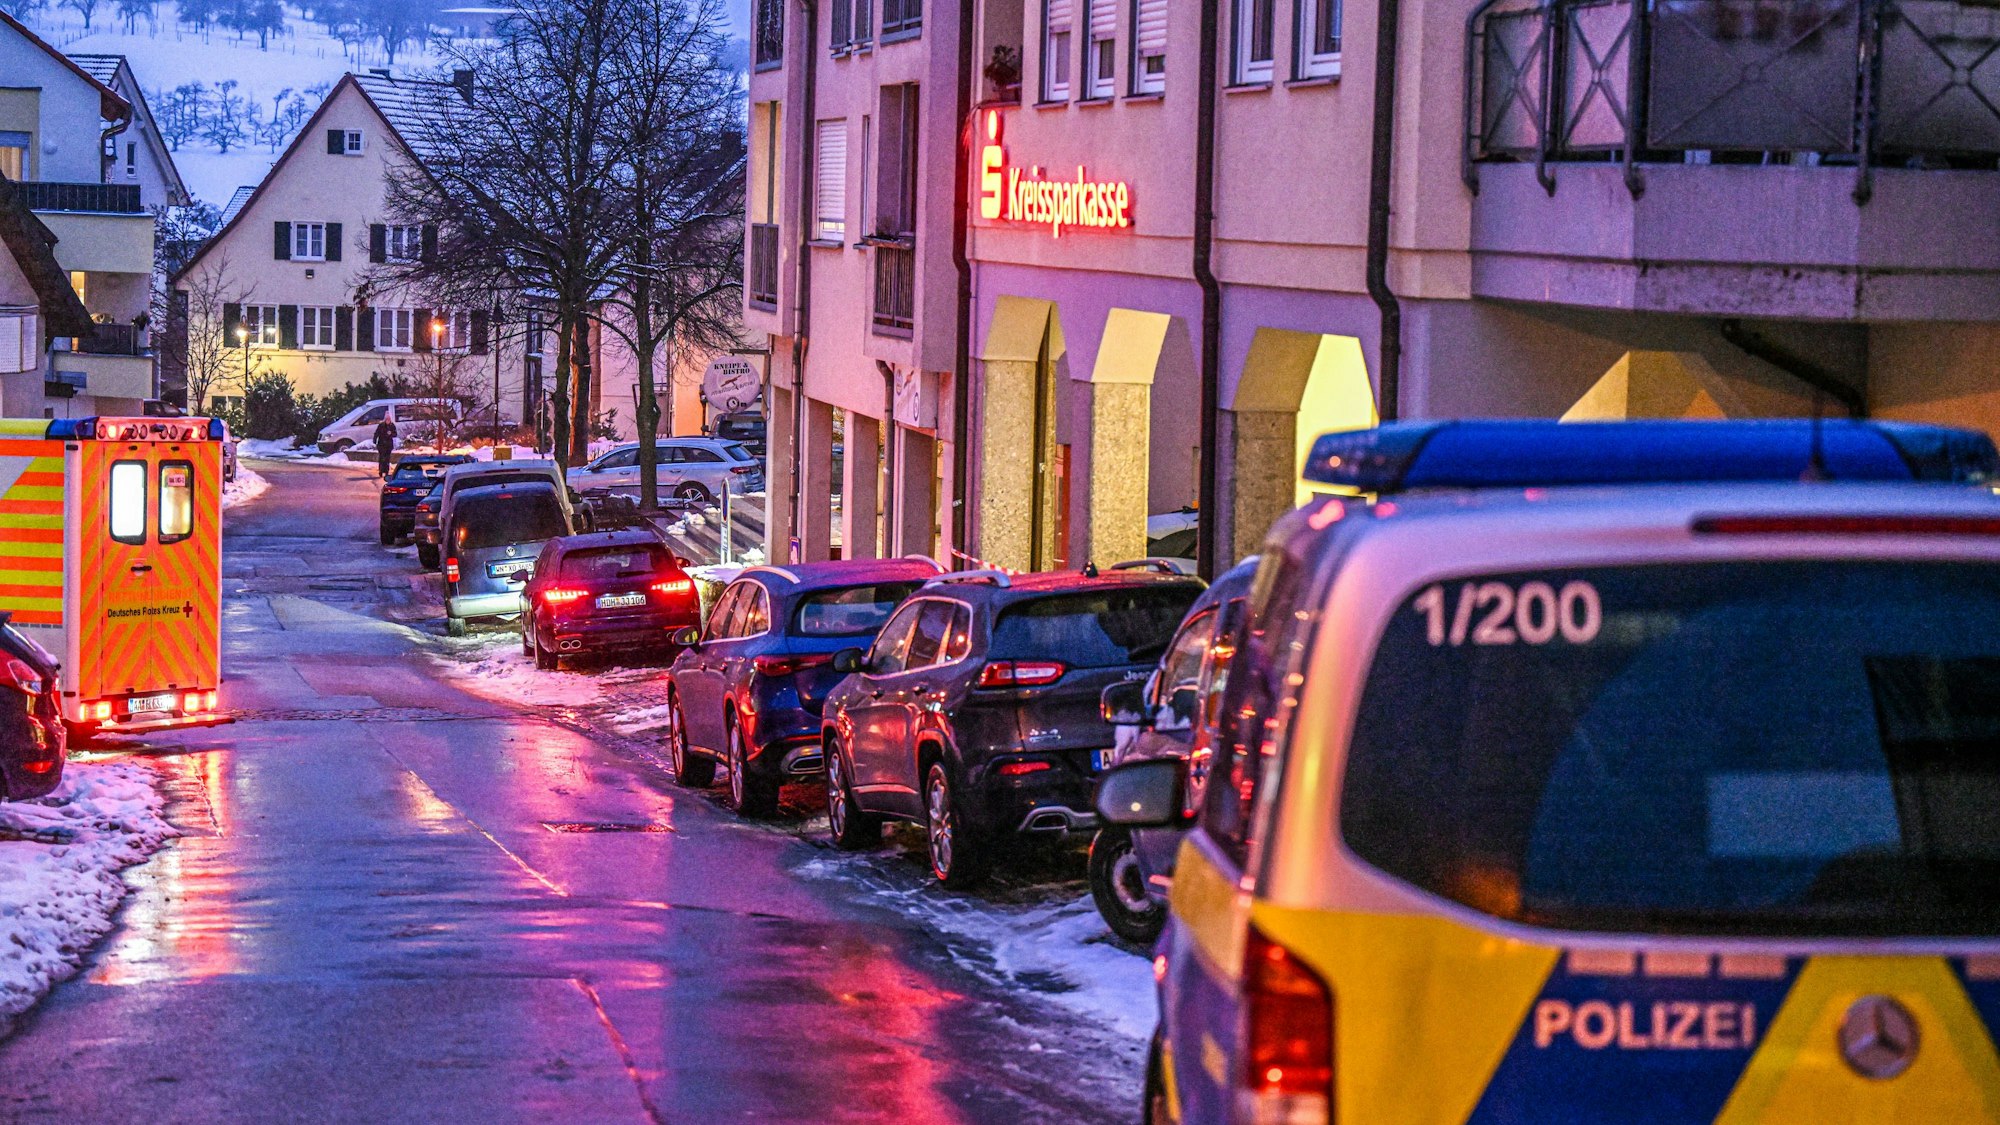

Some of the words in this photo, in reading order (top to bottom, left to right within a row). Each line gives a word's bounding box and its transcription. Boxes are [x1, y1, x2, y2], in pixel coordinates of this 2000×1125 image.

[1008, 165, 1128, 239] Kreissparkasse
[107, 608, 141, 618] Deutsches
[162, 605, 180, 614] Kreuz
[1413, 581, 1602, 646] 1/200
[1534, 1000, 1756, 1050] POLIZEI
